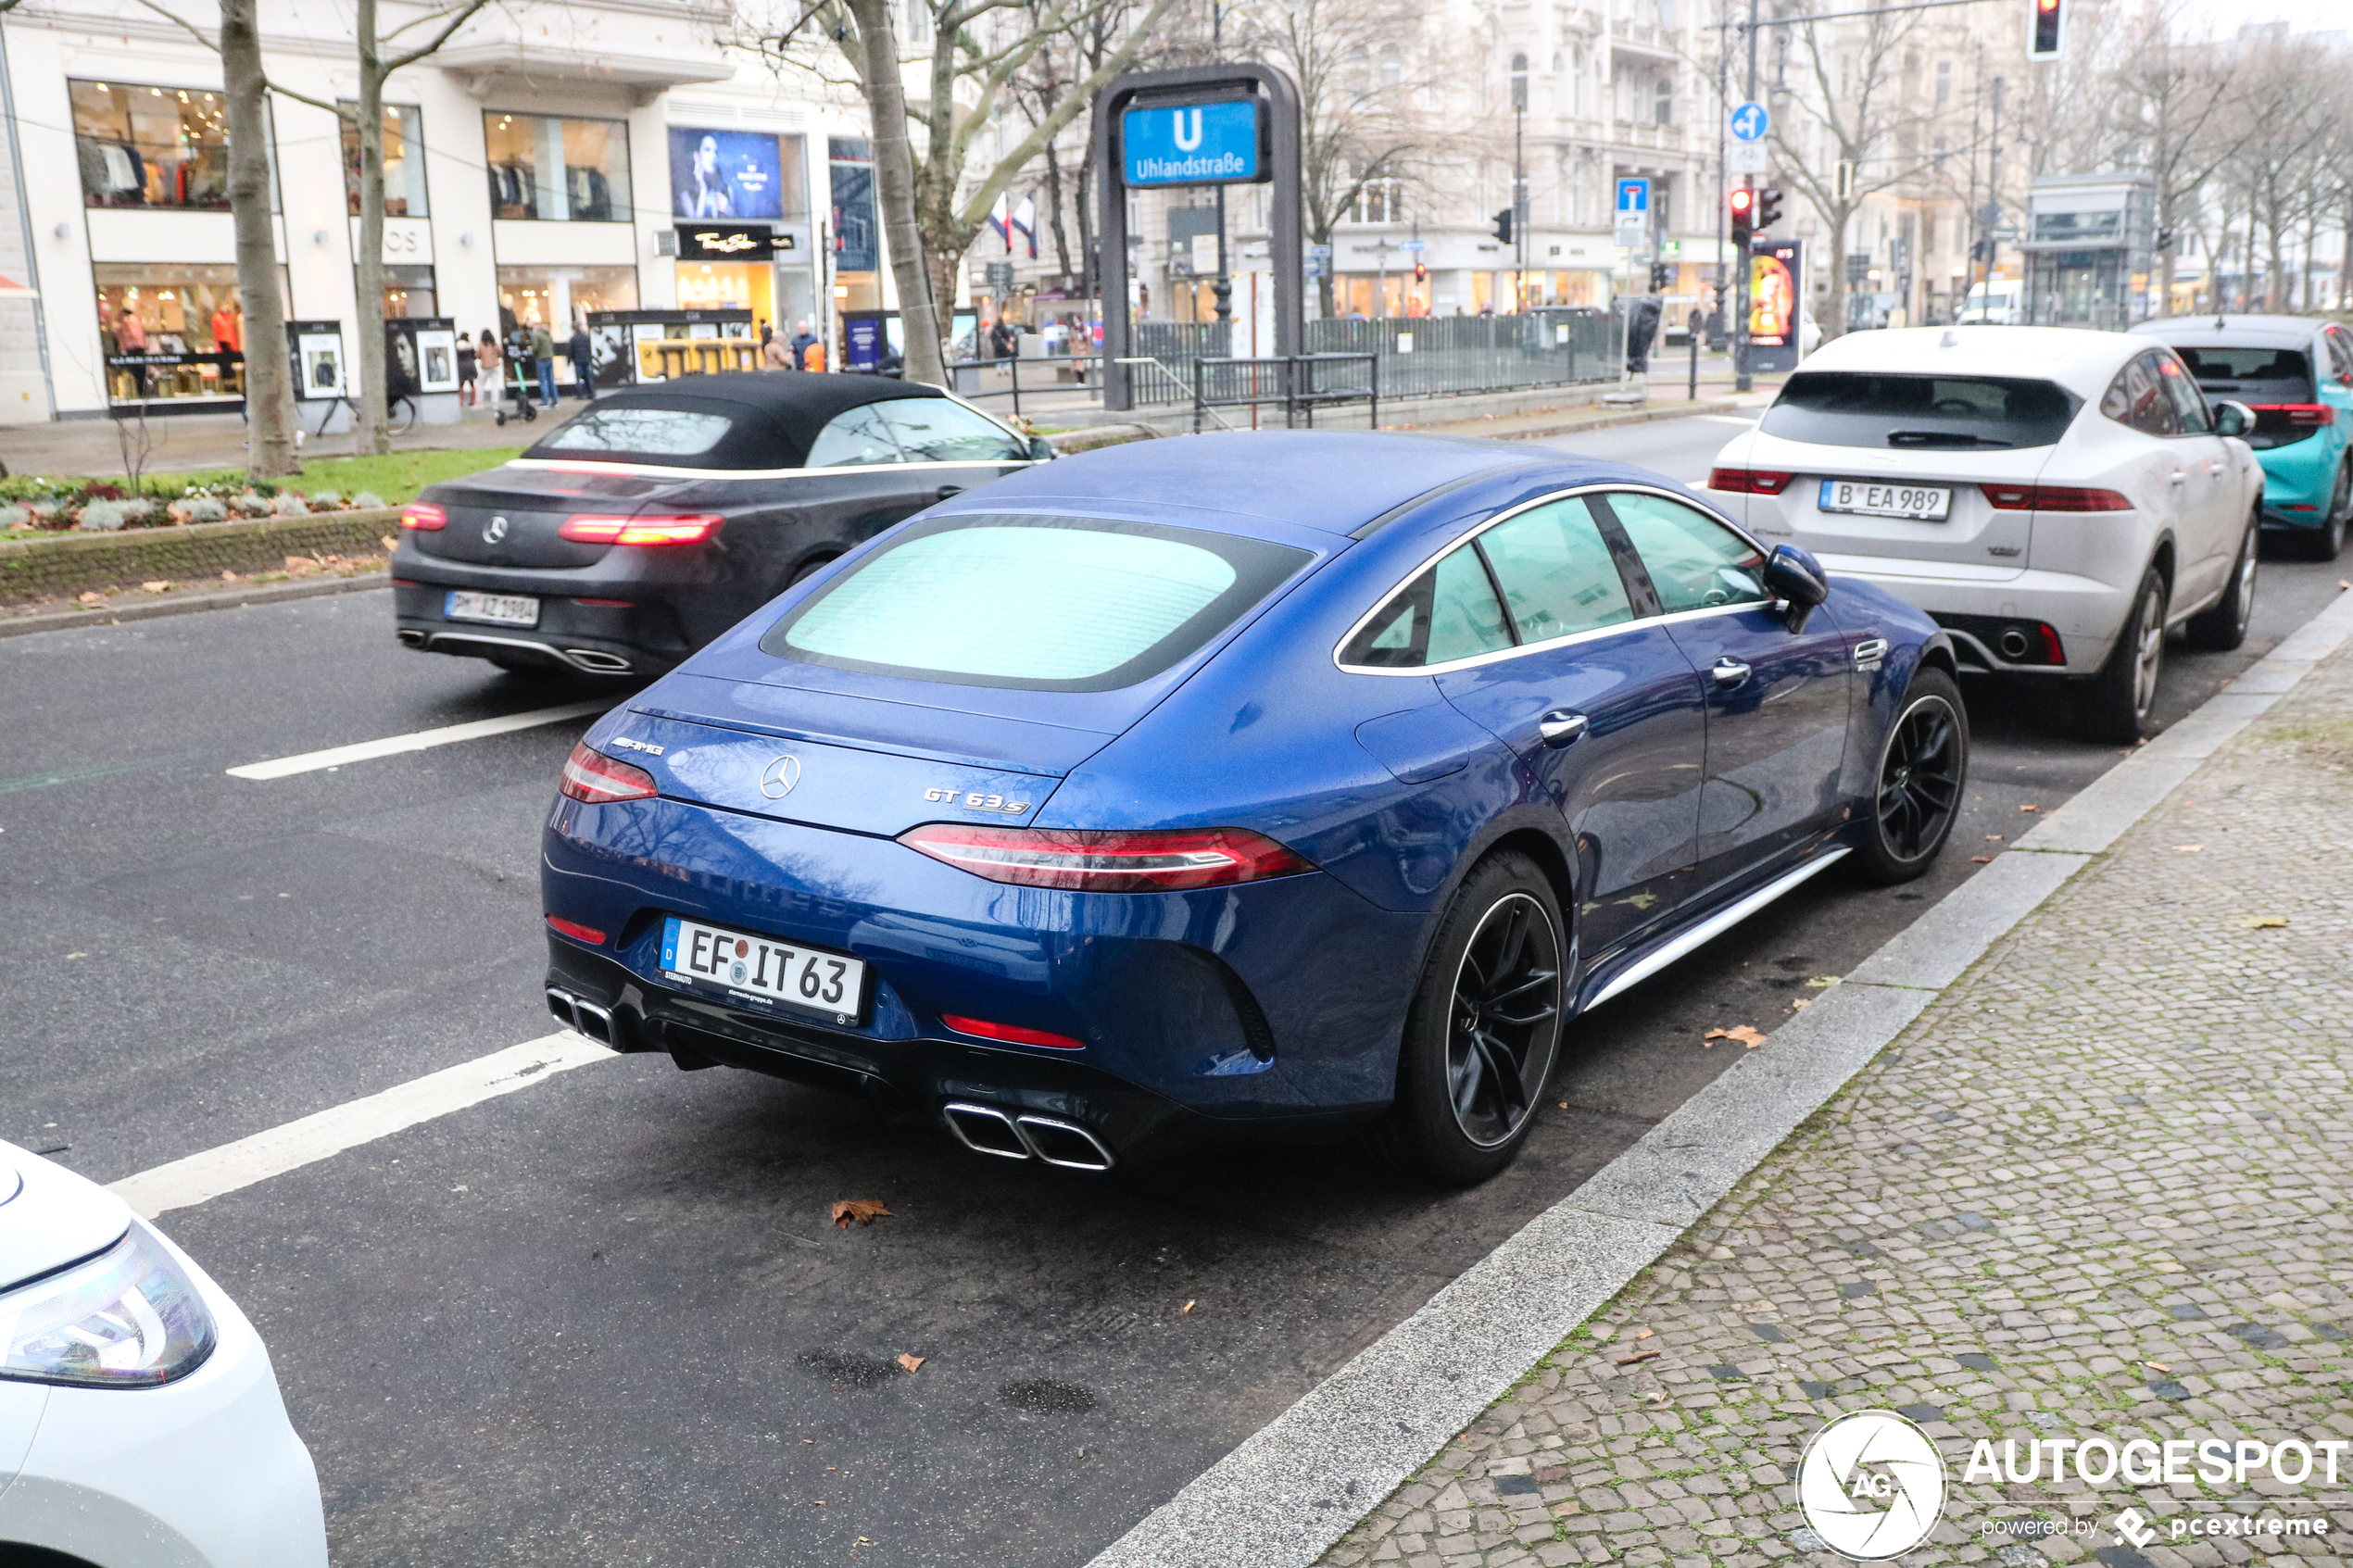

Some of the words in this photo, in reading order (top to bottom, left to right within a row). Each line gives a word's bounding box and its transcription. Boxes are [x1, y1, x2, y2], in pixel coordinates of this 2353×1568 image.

[1174, 108, 1202, 151] U
[1137, 152, 1245, 180] Uhlandstraße
[1839, 485, 1853, 505] B
[1867, 487, 1894, 508] EA
[1900, 489, 1940, 511] 989
[626, 740, 665, 757] AMG
[924, 787, 961, 804] GT
[665, 948, 673, 960] D
[690, 930, 734, 974] EF
[751, 945, 794, 991] IT
[799, 957, 847, 1003] 63
[665, 972, 692, 985] STERNAUTO
[728, 989, 774, 1005] sternauto-gruppe.de
